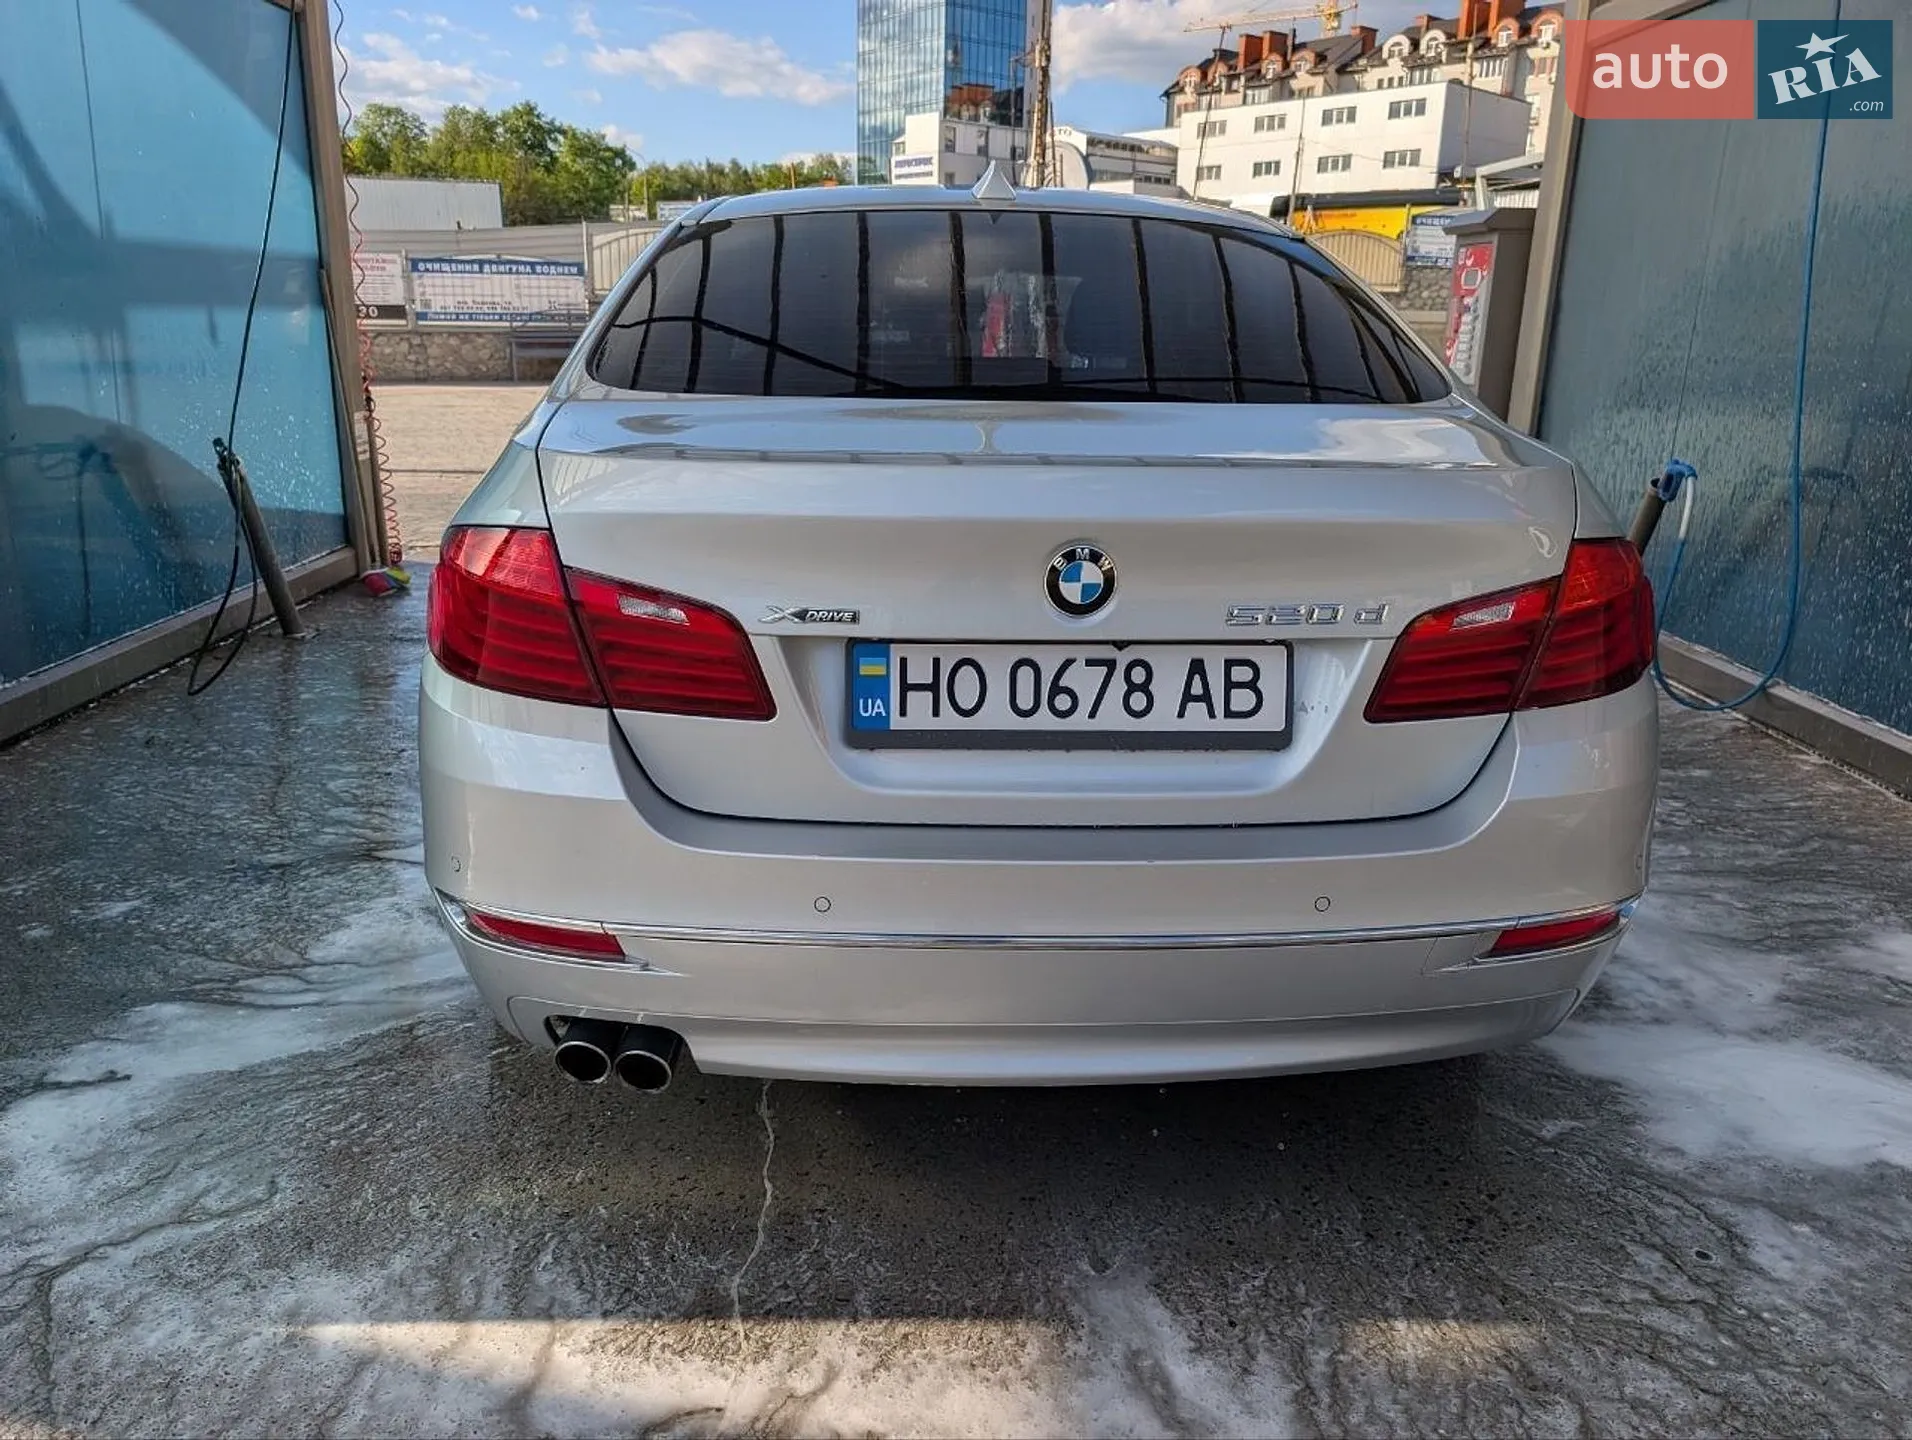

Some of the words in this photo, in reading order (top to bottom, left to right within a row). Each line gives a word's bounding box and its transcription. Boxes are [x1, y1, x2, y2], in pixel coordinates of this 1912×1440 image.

[418, 261, 480, 273] ОЧИЩЕННЯ
[483, 262, 532, 274] ДВИГУНА
[535, 264, 579, 275] ВОДНЕМ
[1053, 548, 1114, 571] BMW
[1226, 603, 1345, 626] 520
[1353, 602, 1389, 625] d
[898, 656, 988, 719] HO
[1008, 656, 1155, 720] 0678
[1176, 656, 1264, 720] AB
[859, 697, 886, 717] UA
